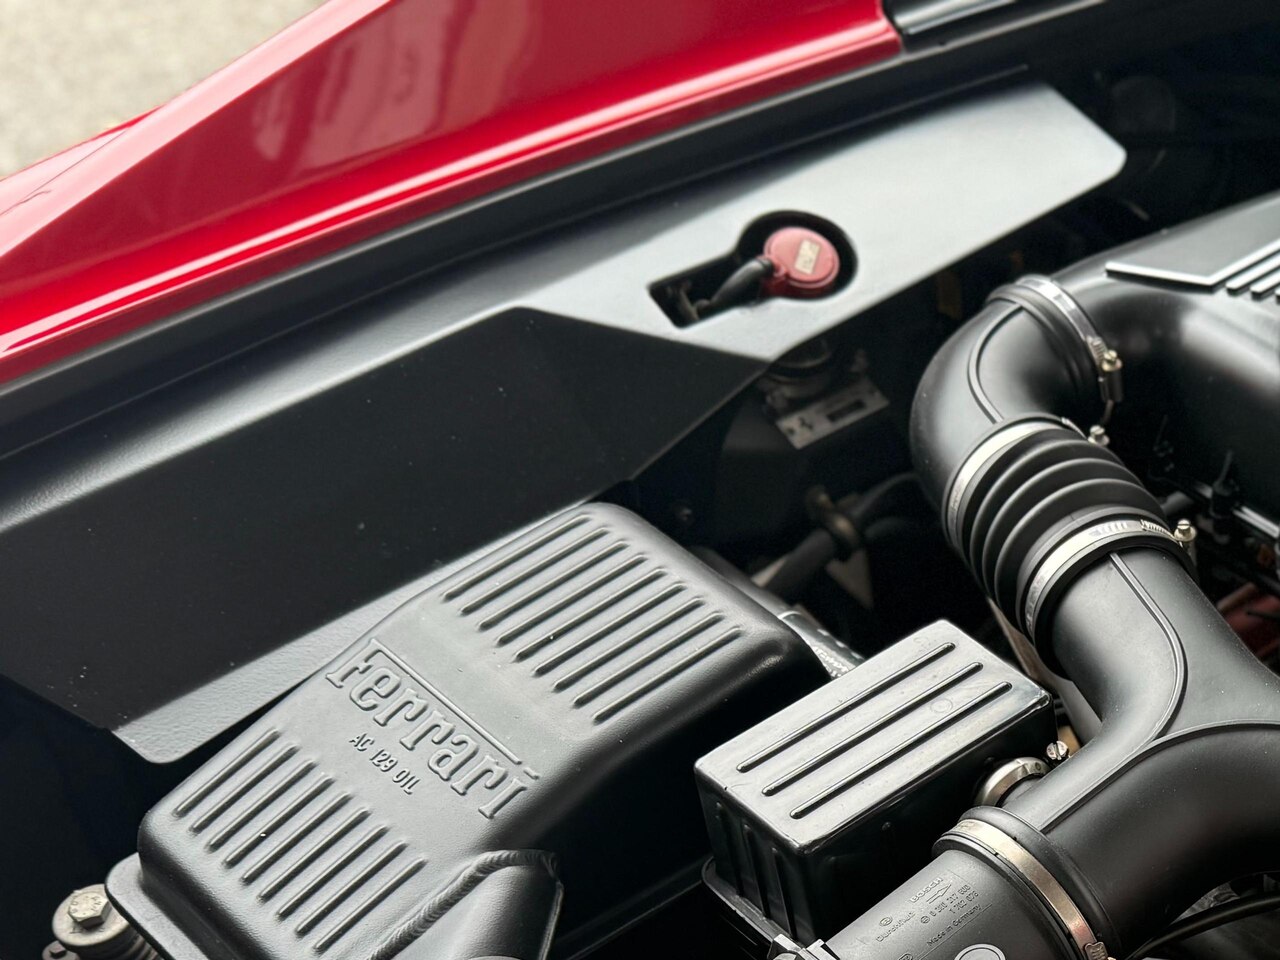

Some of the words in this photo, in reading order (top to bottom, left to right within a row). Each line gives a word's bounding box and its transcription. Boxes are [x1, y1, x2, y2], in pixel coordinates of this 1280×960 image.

[326, 638, 541, 820] Ferrari
[349, 733, 375, 752] AC
[369, 749, 398, 772] 129
[927, 931, 946, 947] Made
[952, 904, 981, 927] Germany
